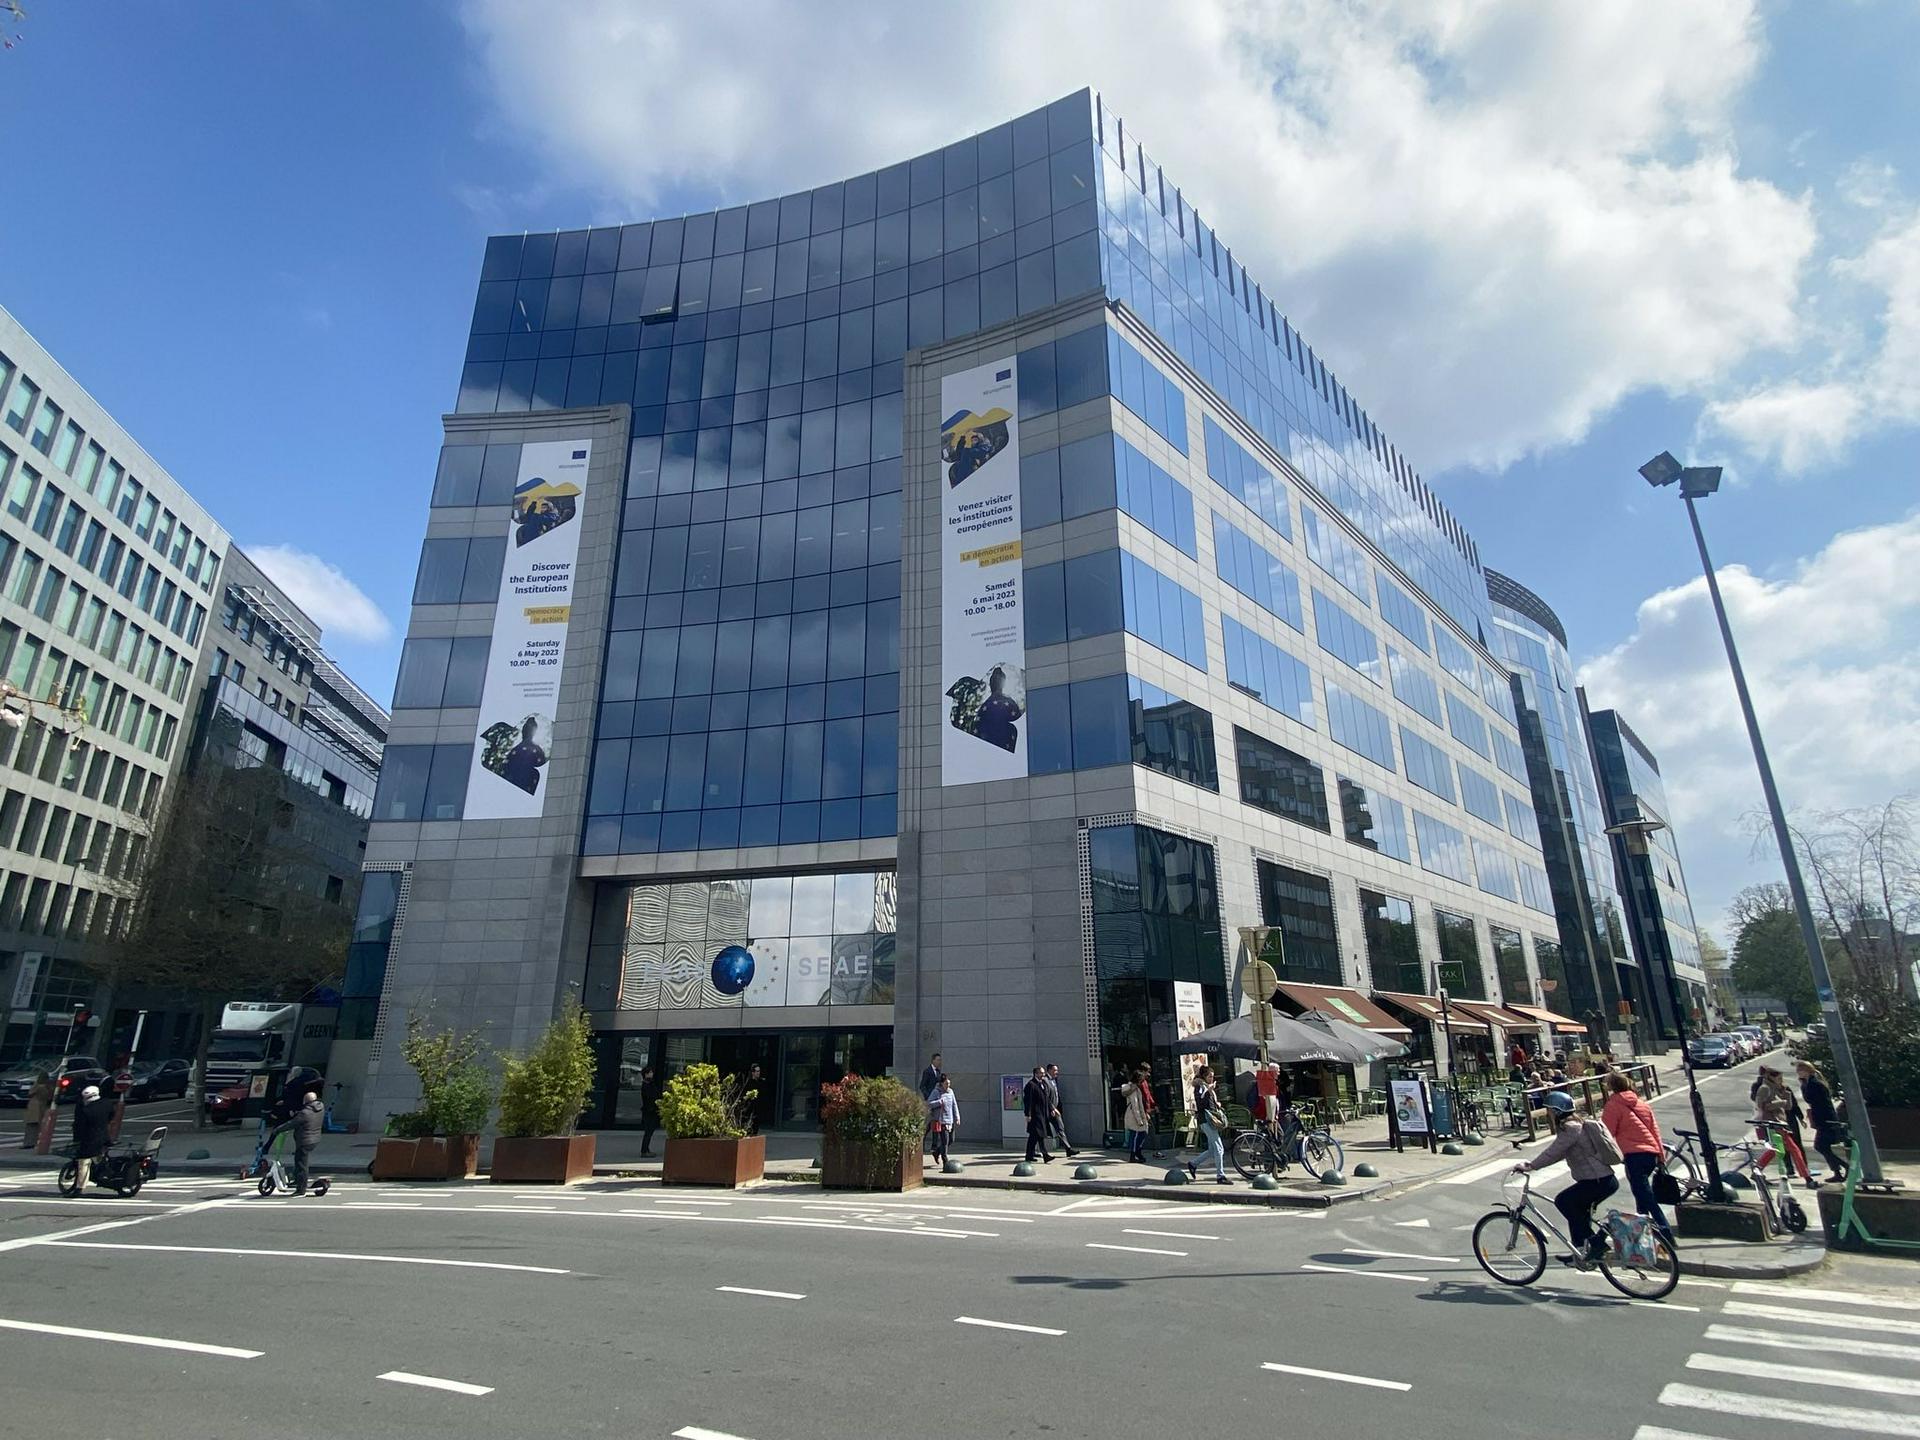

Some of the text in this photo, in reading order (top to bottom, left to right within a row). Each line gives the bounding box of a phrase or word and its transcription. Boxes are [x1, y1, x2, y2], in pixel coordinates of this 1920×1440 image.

[958, 494, 1013, 512] Venez visiter
[949, 504, 1013, 525] les institutions
[957, 515, 1013, 534] européennes
[980, 553, 1015, 567] en action
[531, 563, 571, 572] Discover
[509, 574, 569, 583] the European
[985, 578, 1015, 592] Samedi
[514, 584, 567, 594] Institutions
[972, 590, 1016, 605] 6 mai 2023
[964, 606, 986, 616] 10.00
[994, 600, 1016, 611] 18.00
[526, 640, 560, 648] Saturday
[524, 650, 539, 658] May
[799, 955, 868, 976] SEAE
